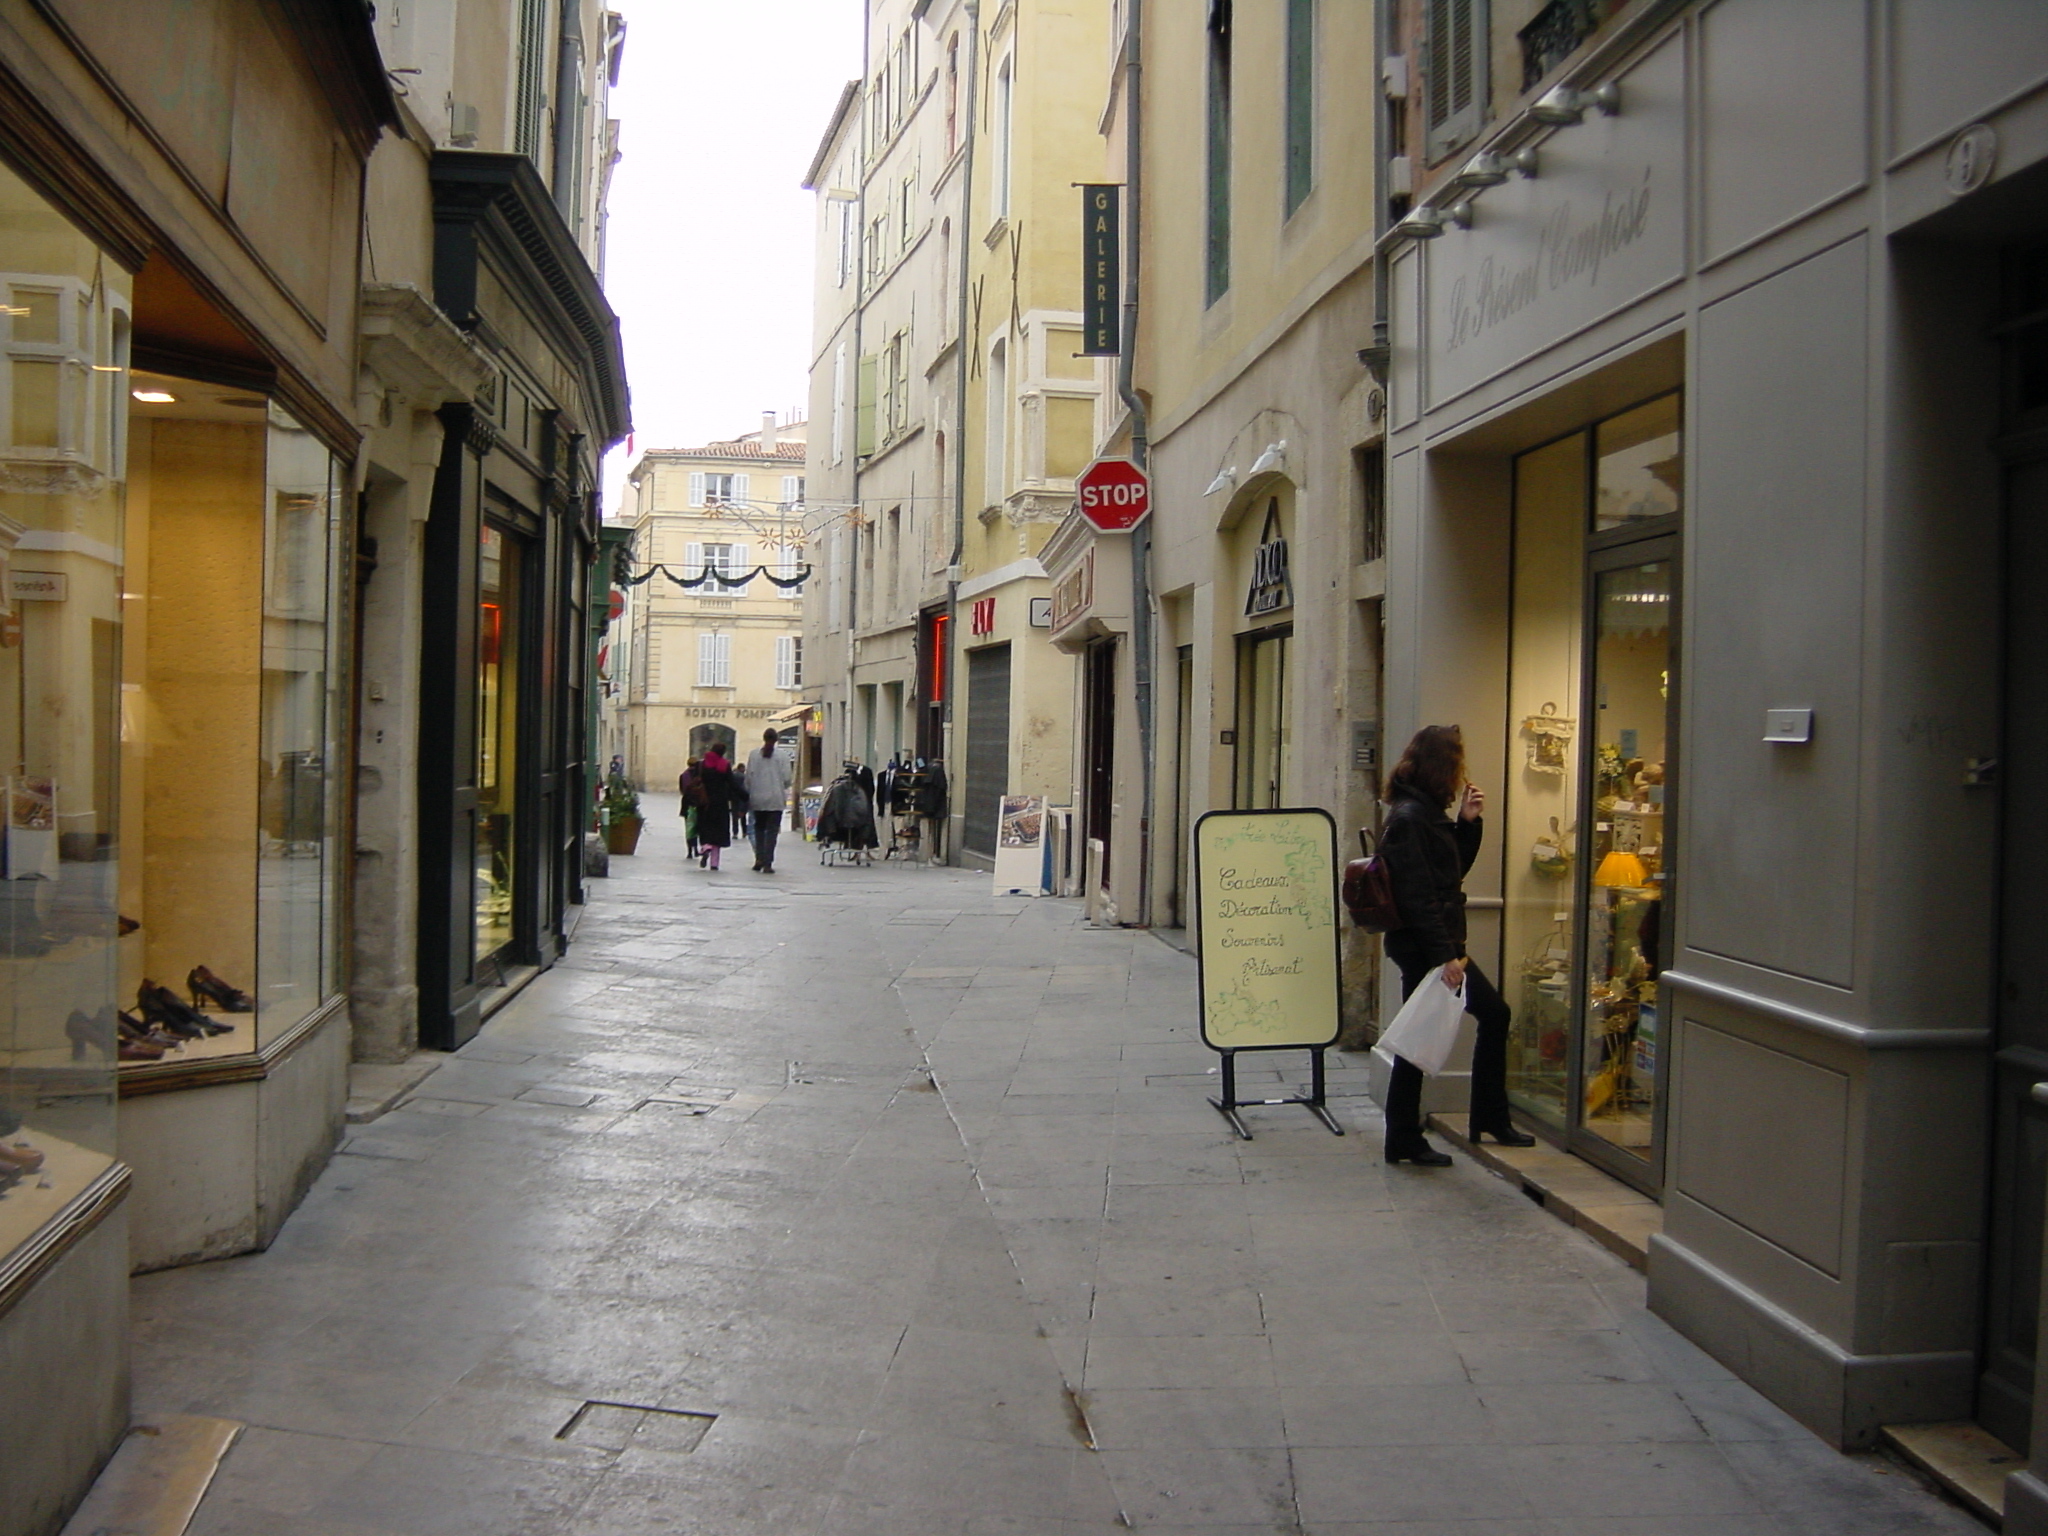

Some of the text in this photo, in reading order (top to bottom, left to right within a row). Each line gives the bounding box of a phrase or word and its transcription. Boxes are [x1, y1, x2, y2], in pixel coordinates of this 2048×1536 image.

[1095, 193, 1107, 347] GALERIE
[1447, 274, 1470, 352] Le
[1549, 164, 1651, 291] Composé
[1083, 483, 1146, 507] STOP
[685, 708, 727, 719] ROBLOT
[1218, 895, 1294, 919] Décoration
[1221, 928, 1285, 949] Souvenirs
